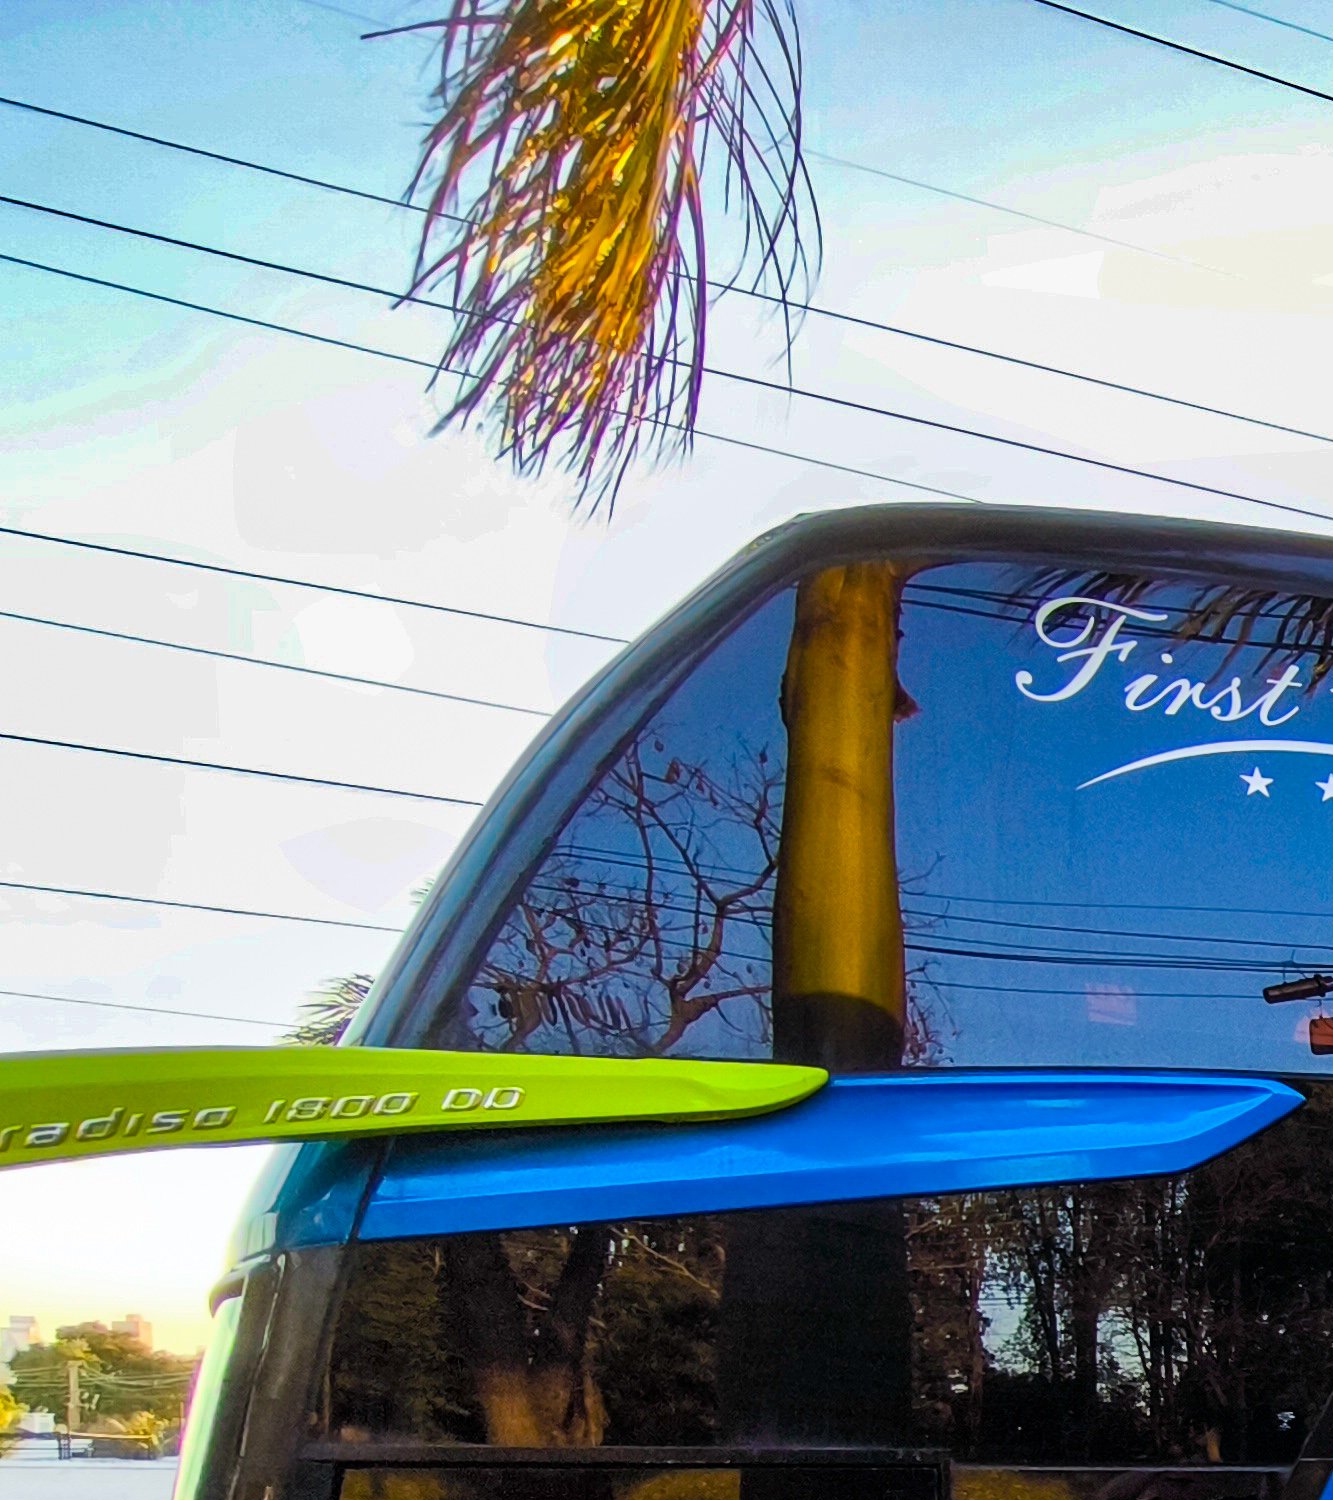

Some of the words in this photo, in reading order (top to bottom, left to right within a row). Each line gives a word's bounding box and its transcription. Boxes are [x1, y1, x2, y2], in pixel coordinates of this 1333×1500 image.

[1015, 597, 1303, 727] First
[262, 1092, 420, 1123] 1800
[440, 1085, 526, 1112] DD
